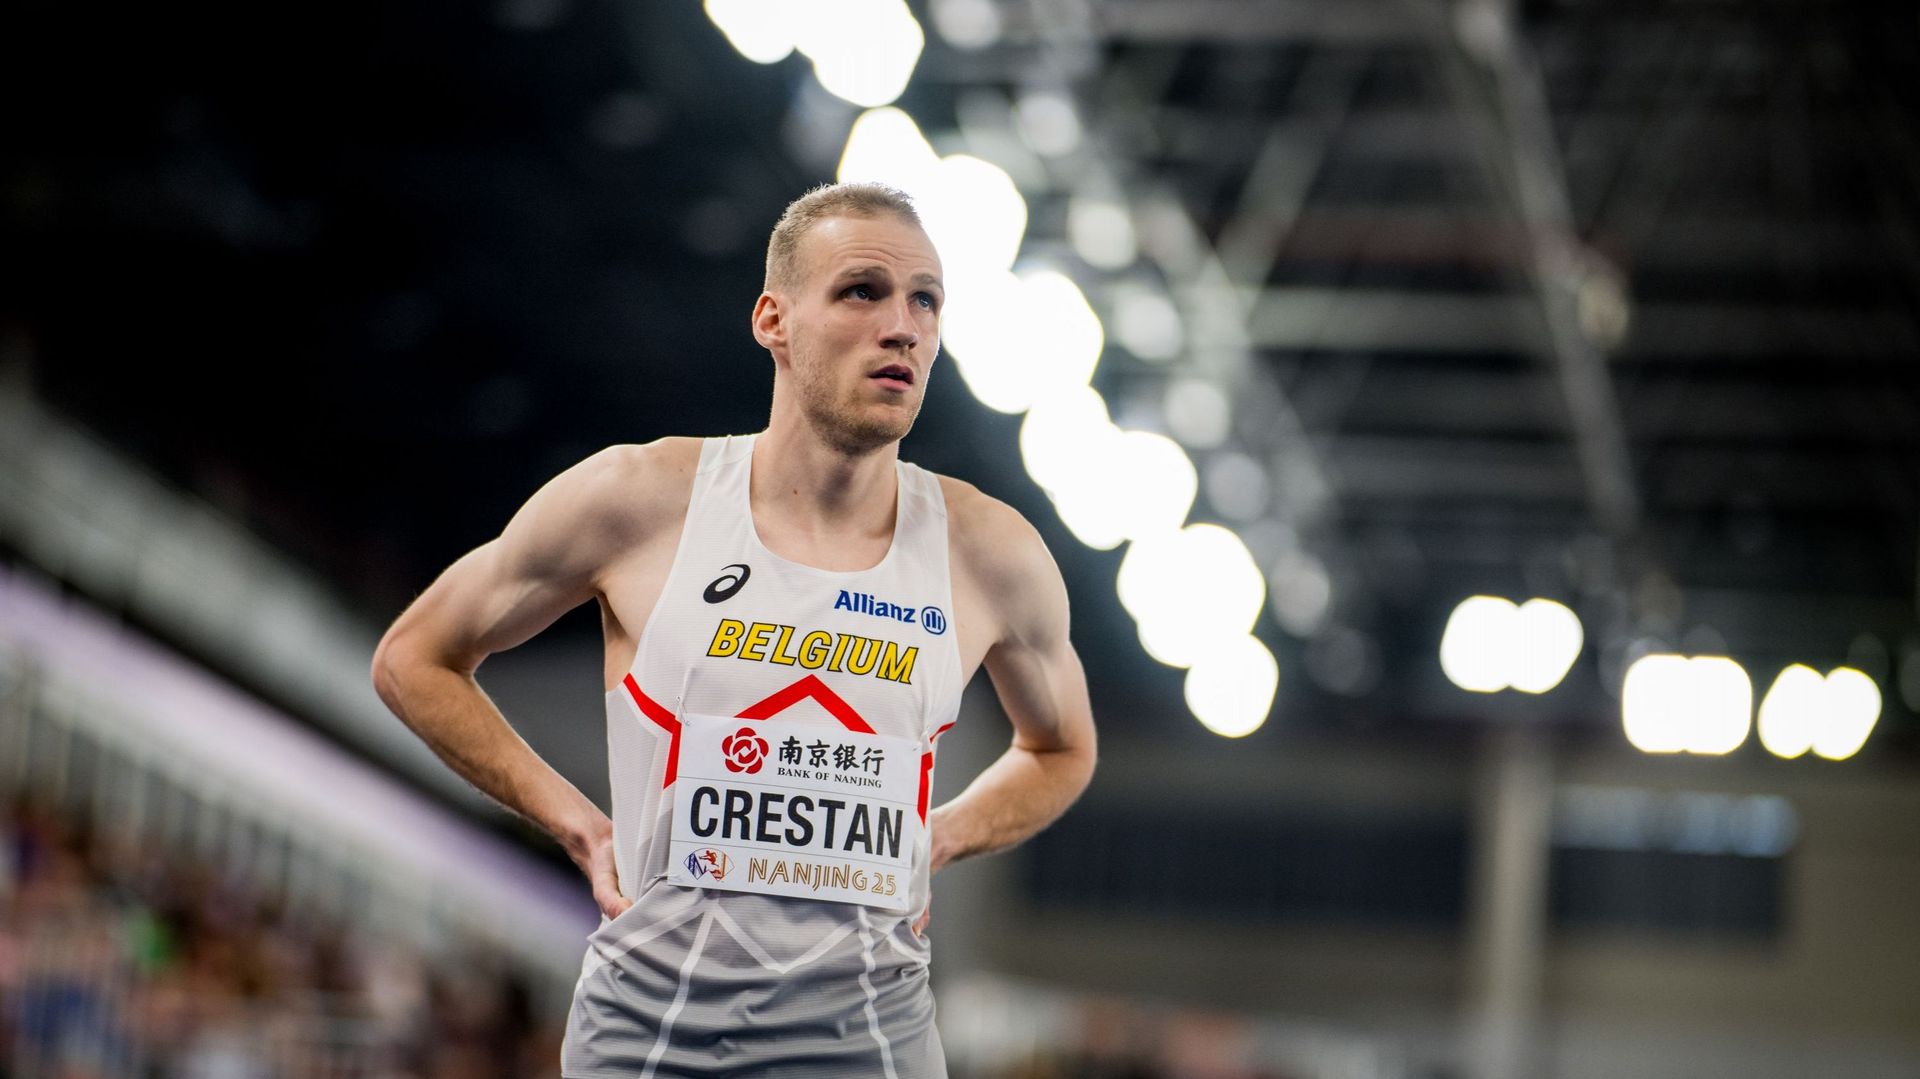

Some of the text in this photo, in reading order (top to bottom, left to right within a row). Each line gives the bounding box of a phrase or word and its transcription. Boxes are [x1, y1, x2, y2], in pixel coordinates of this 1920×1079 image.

[834, 590, 916, 623] Allianz
[706, 618, 919, 685] BELGIUM
[778, 736, 885, 776] 南京银行
[777, 768, 882, 789] BANK OF NANJING
[690, 786, 903, 858] CRESTAN
[747, 857, 896, 896] NANJING 25
